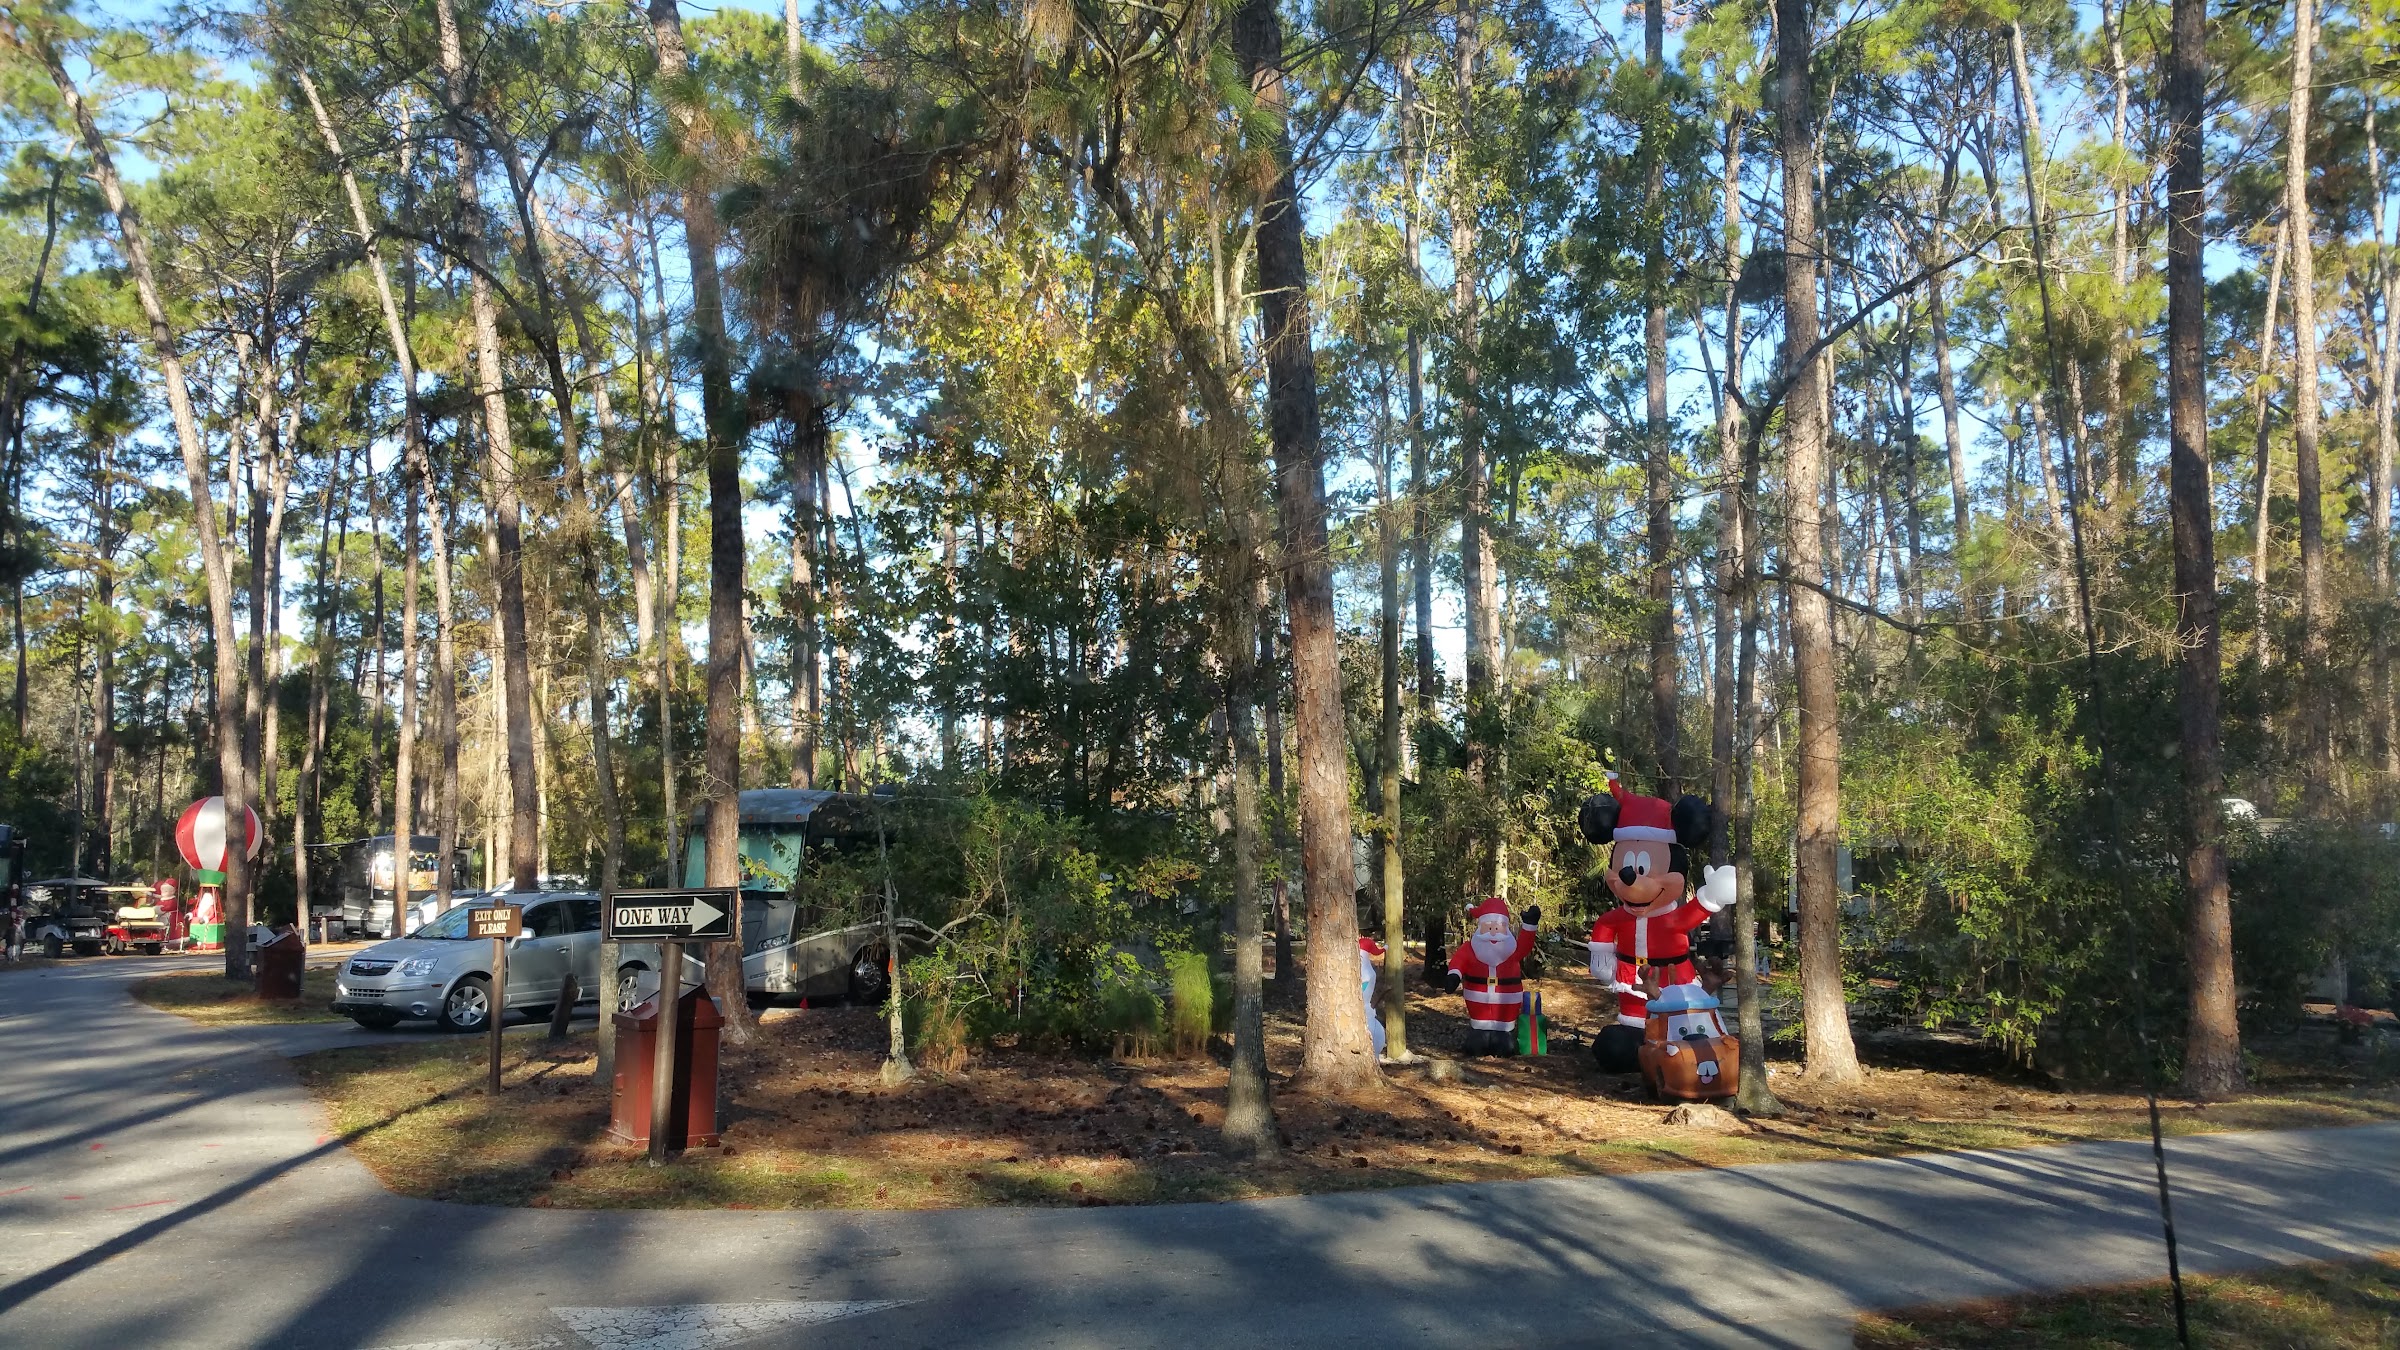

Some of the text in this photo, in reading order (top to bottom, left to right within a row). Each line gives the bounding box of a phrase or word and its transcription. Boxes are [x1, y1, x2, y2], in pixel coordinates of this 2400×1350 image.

[474, 909, 511, 921] EXIT ONLY
[619, 907, 691, 925] ONE WAY
[479, 922, 507, 934] PLEASE
